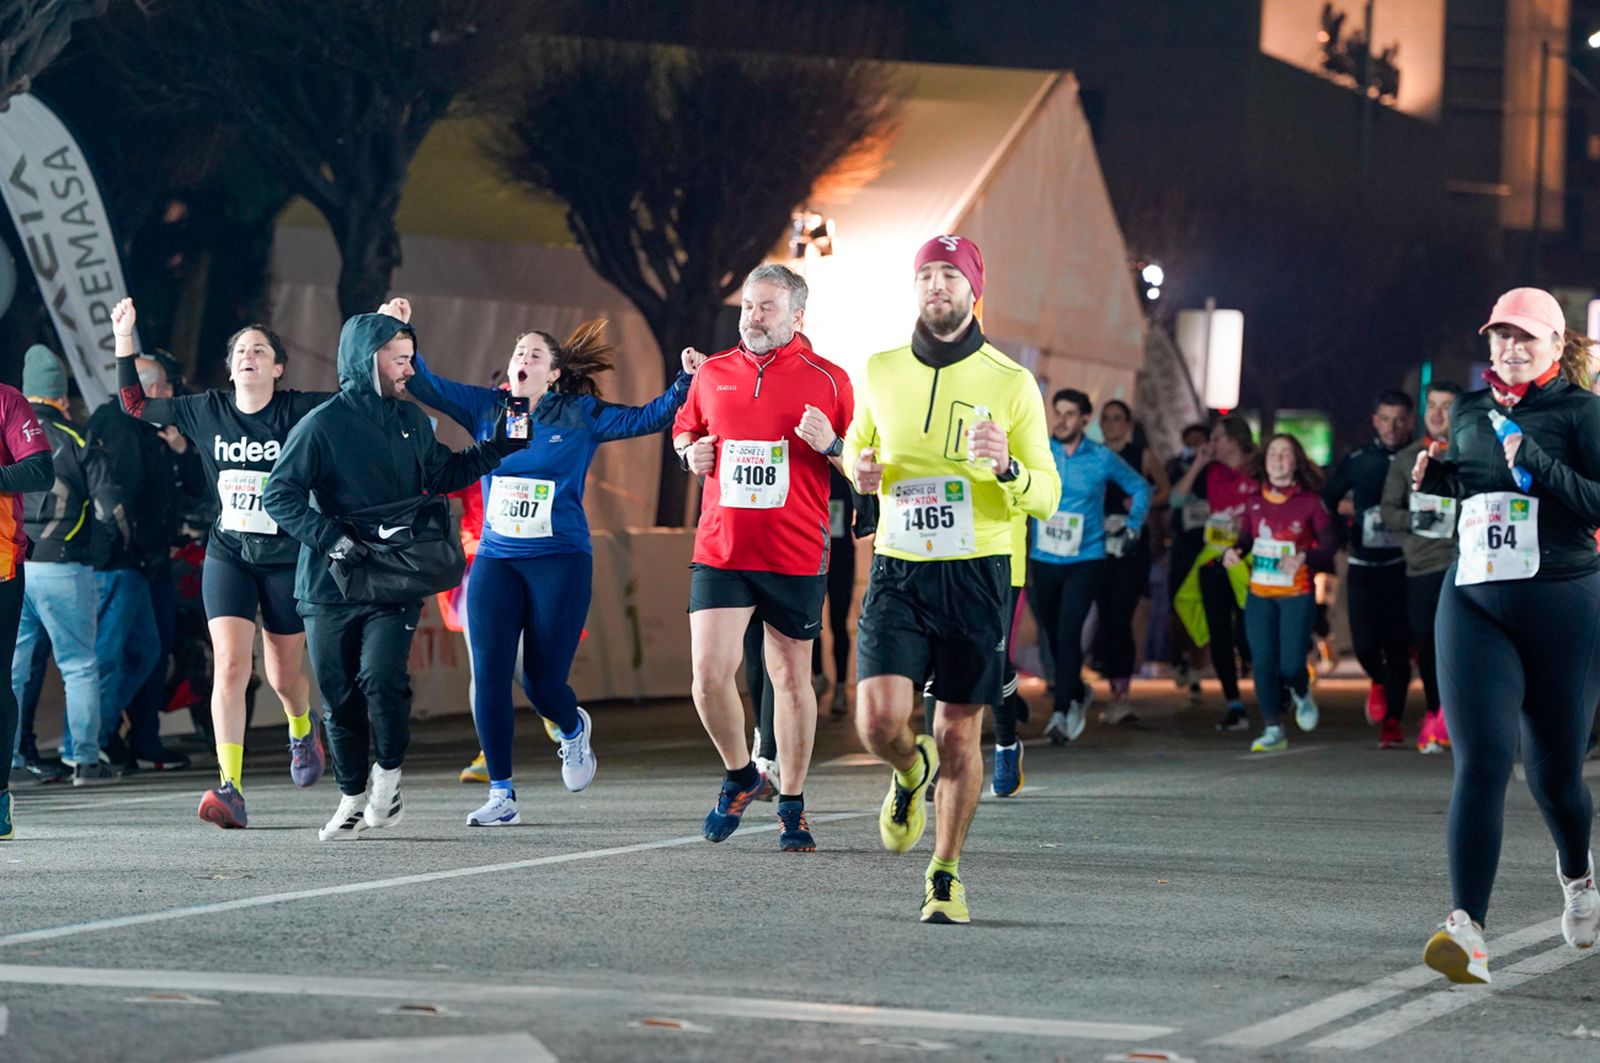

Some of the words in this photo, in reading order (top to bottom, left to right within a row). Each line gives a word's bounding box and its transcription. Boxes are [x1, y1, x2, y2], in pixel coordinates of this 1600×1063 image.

[732, 464, 777, 486] 4108
[230, 492, 263, 512] 4271
[500, 499, 540, 518] 2607
[903, 505, 955, 532] 1465
